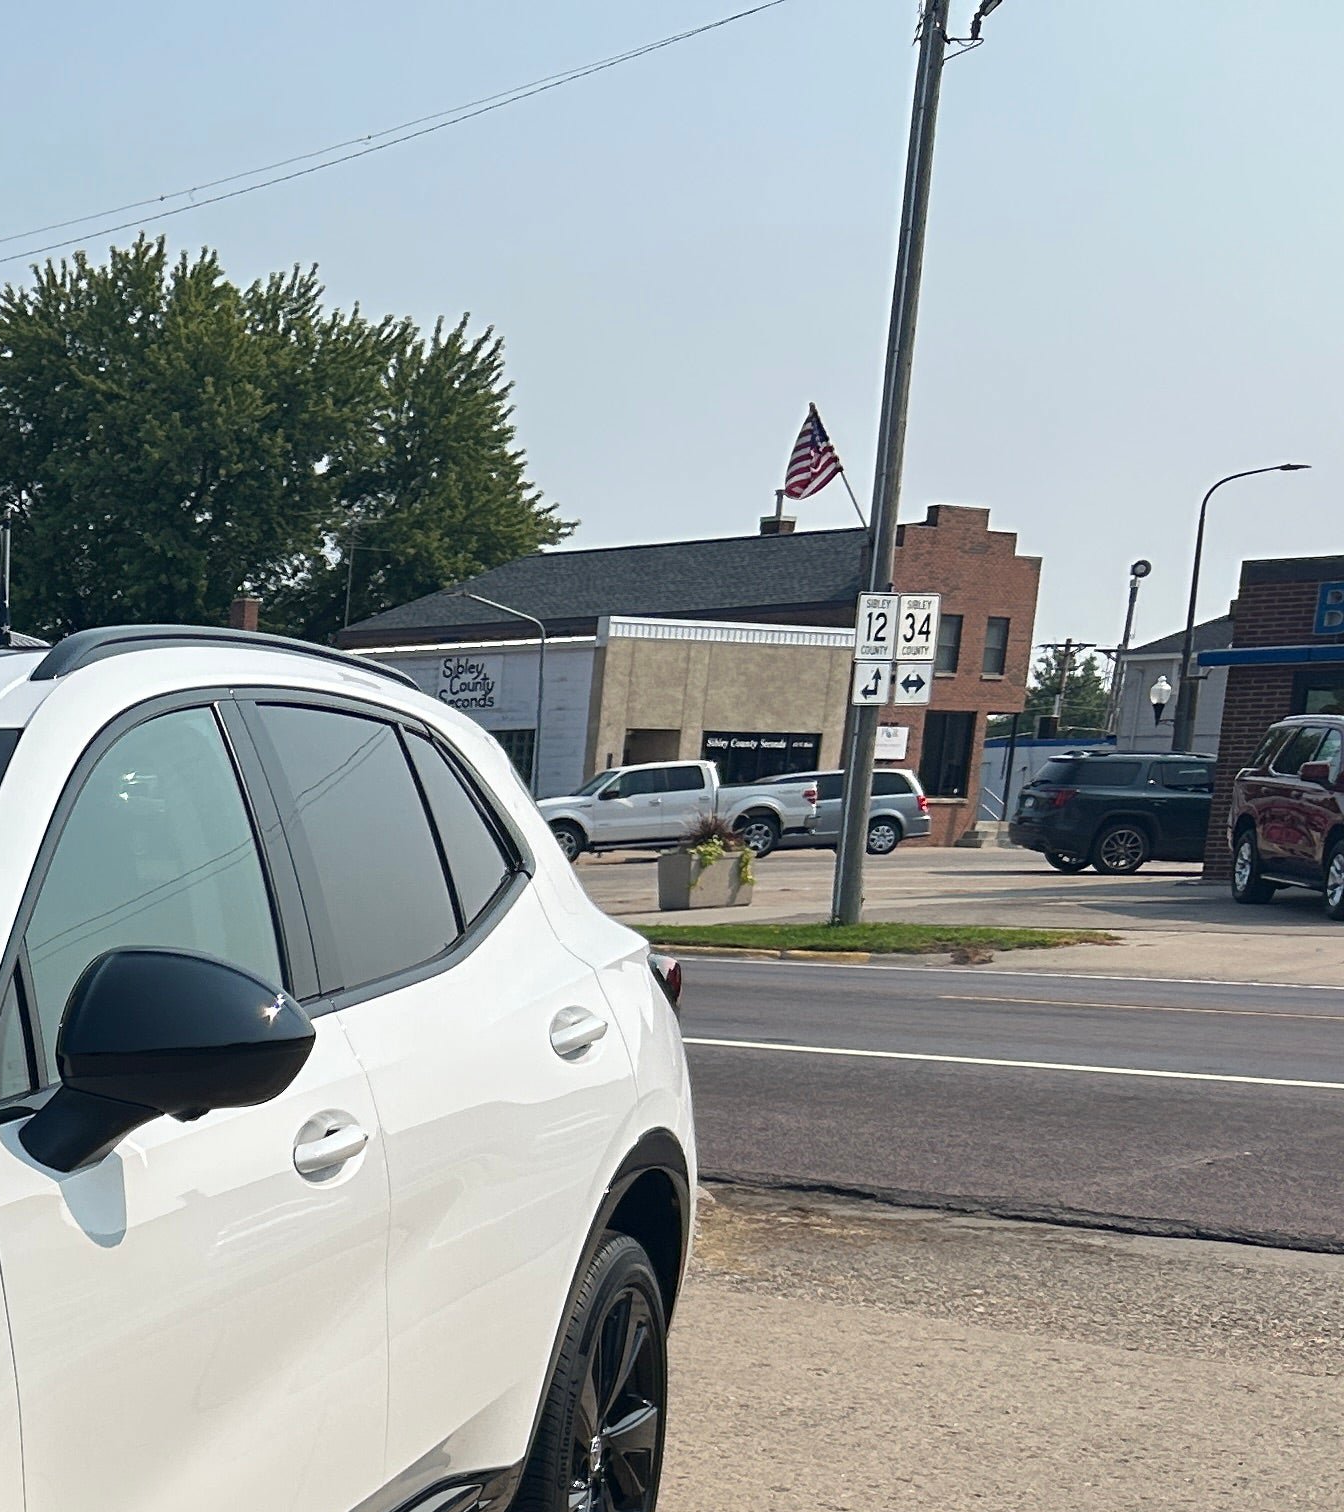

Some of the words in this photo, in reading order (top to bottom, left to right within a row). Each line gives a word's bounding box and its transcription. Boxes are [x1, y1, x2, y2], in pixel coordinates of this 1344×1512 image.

[866, 598, 891, 609] SIBLEY
[906, 599, 932, 610] SIBLEY
[867, 611, 888, 642] 12
[902, 612, 932, 643] 34
[860, 644, 889, 656] COUNTY
[901, 645, 930, 656] COUNTY
[442, 657, 485, 680] Sibley
[449, 673, 495, 697] County
[438, 689, 495, 708] Seconds
